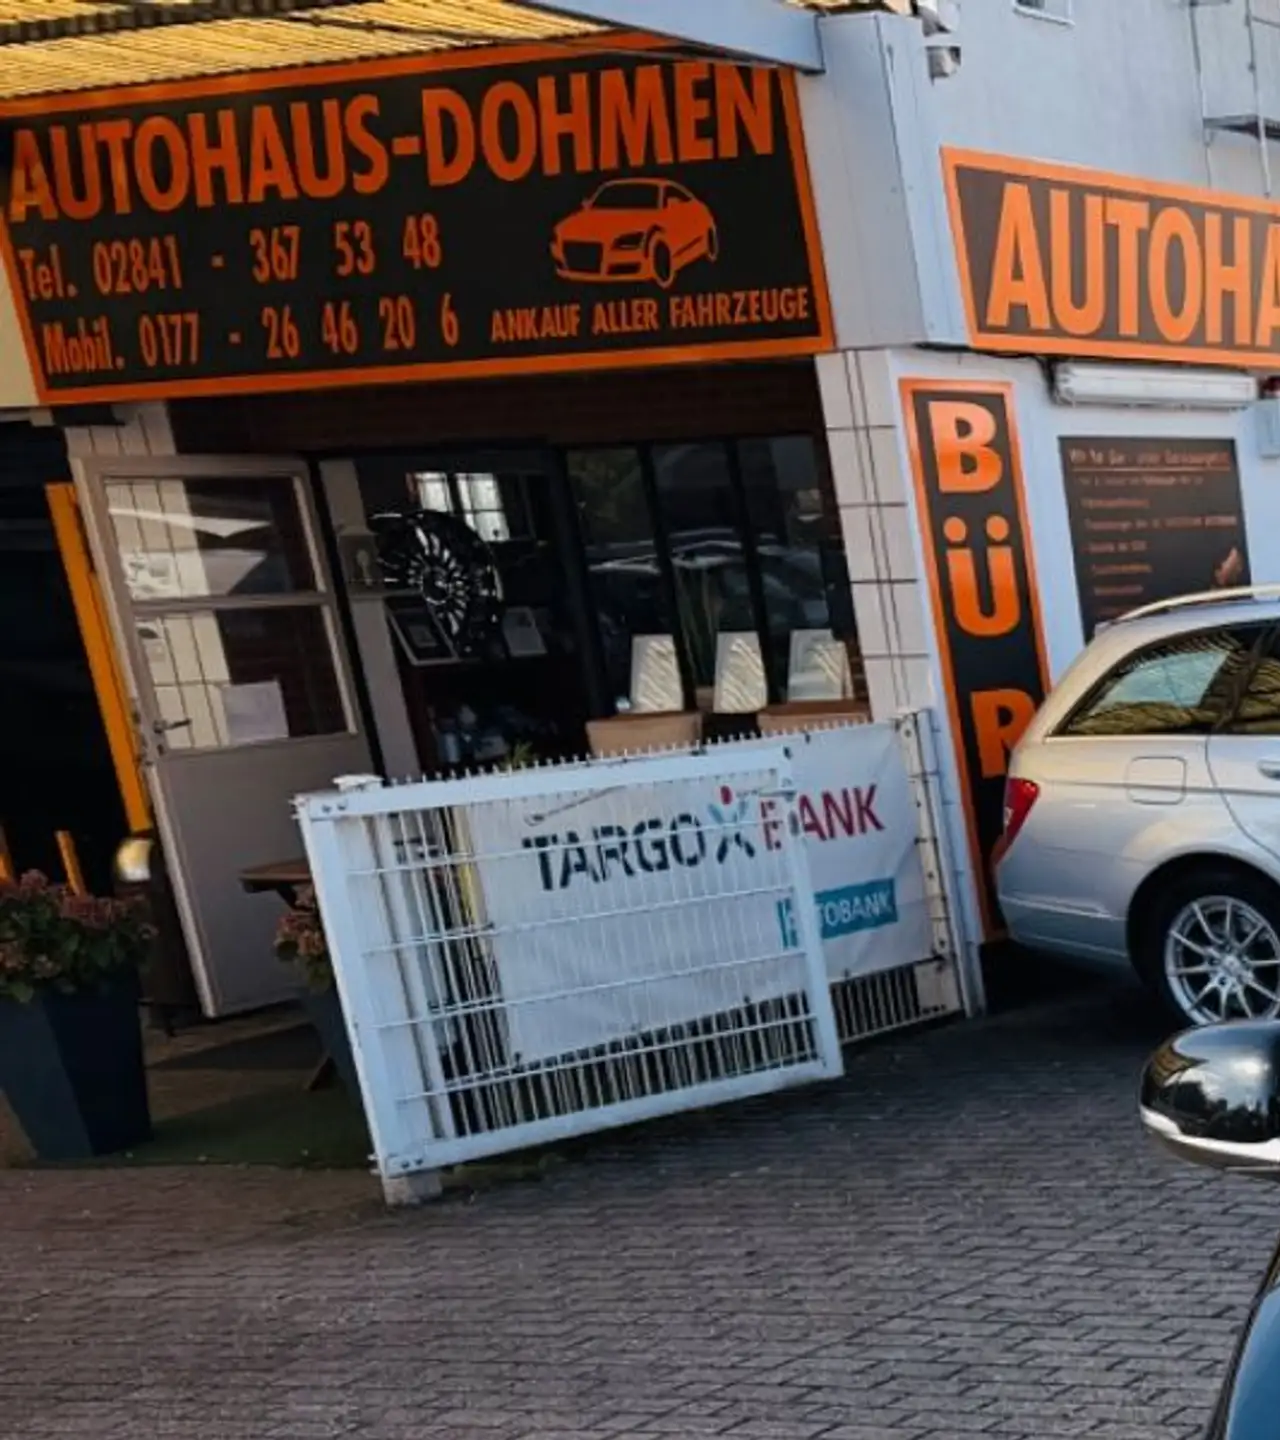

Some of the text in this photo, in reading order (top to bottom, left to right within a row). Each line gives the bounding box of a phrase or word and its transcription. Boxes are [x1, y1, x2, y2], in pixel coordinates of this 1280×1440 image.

[8, 60, 775, 222] AUTOHAUS-DOHMEN
[19, 244, 77, 299] Tel.
[92, 234, 183, 296] 02841
[249, 225, 300, 284] 367
[334, 220, 375, 276] 53
[402, 212, 442, 269] 48
[43, 316, 125, 375] Mobil.
[138, 312, 200, 367] 0177
[261, 305, 300, 360] 26
[322, 301, 359, 355] 46
[379, 296, 416, 350] 20
[441, 293, 459, 348] 6
[491, 287, 810, 342] ANKAUF ALLER FAHRZEUGE
[928, 400, 1037, 778] BÜR
[522, 814, 706, 891] TARGO
